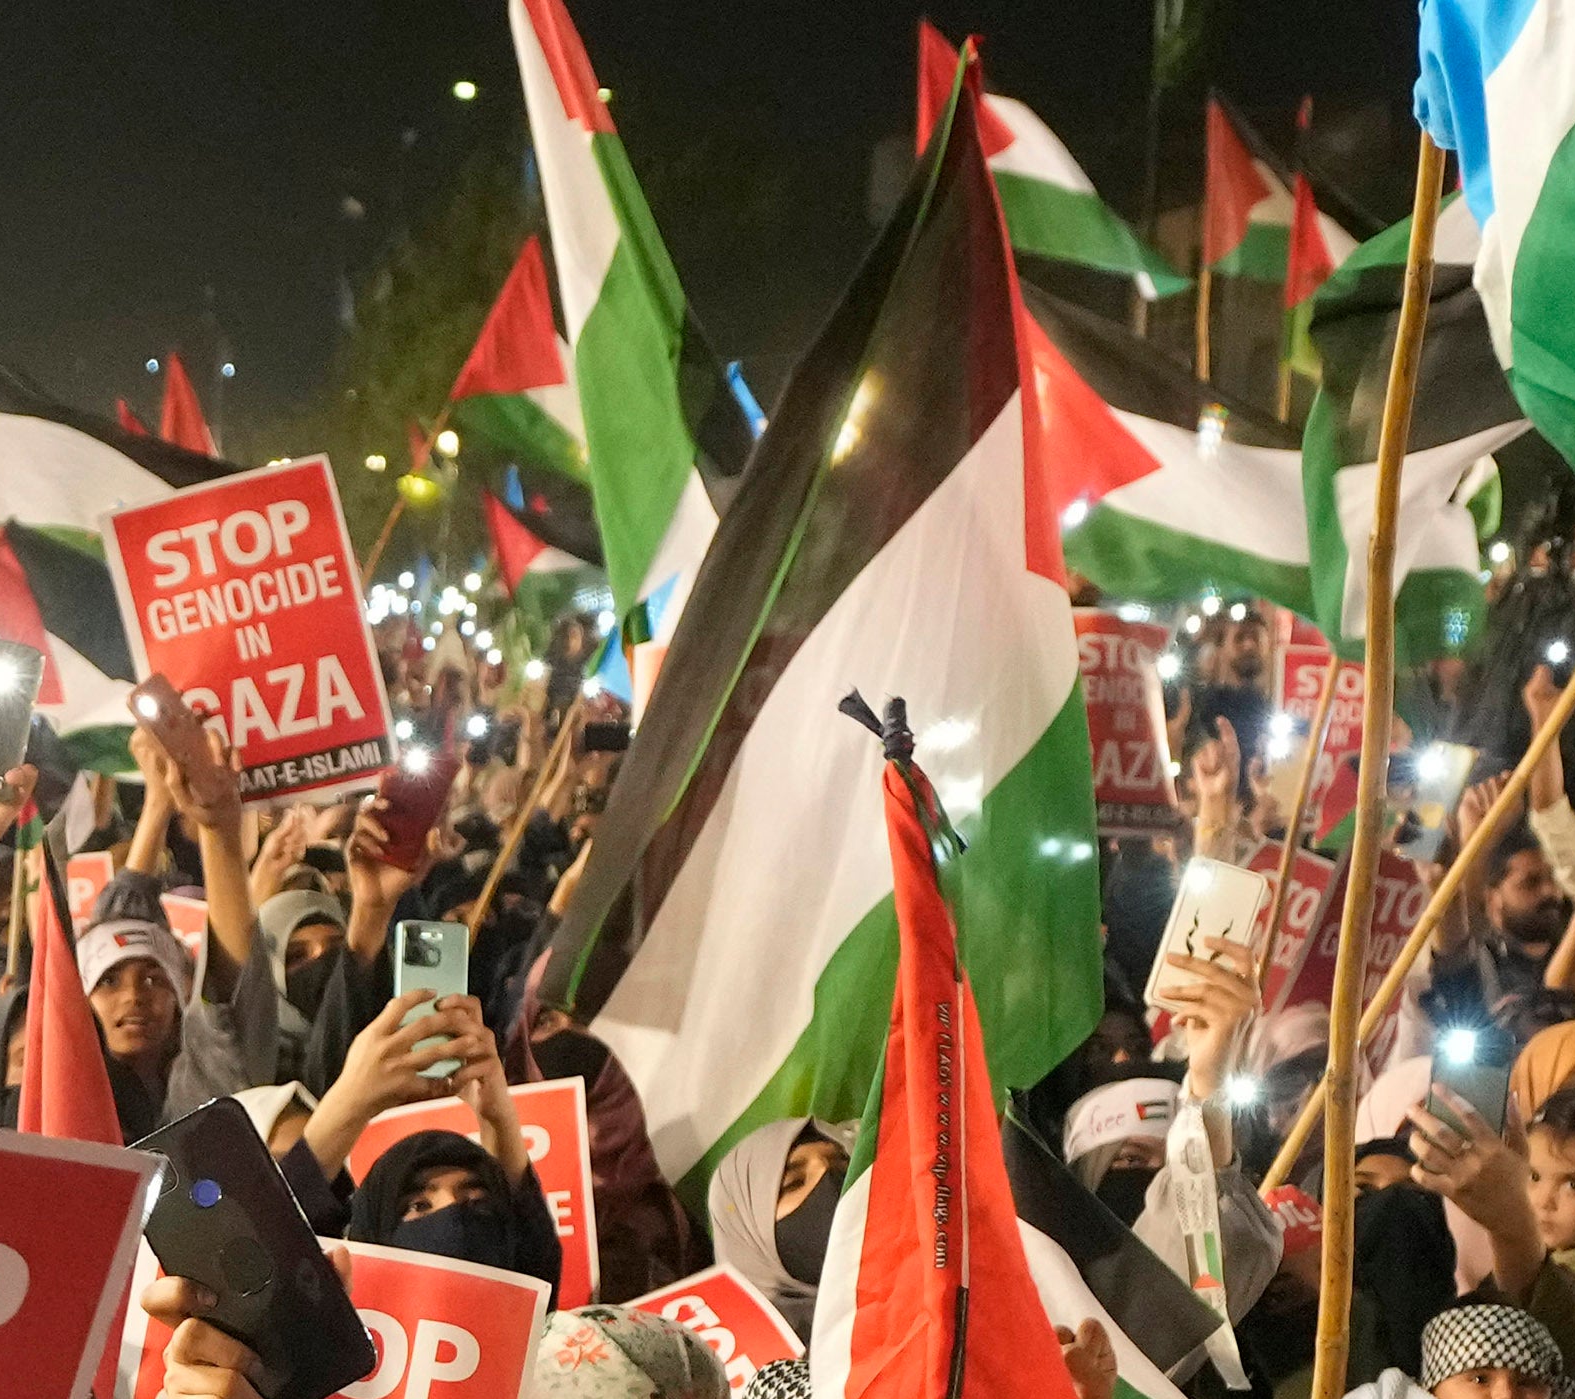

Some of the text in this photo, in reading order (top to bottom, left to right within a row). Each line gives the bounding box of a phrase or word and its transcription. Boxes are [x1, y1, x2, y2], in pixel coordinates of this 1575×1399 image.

[145, 499, 310, 589] STOP
[146, 554, 343, 641] GENOCIDE
[234, 622, 274, 661] IN
[238, 741, 381, 792] AAT-E-ISLAMI
